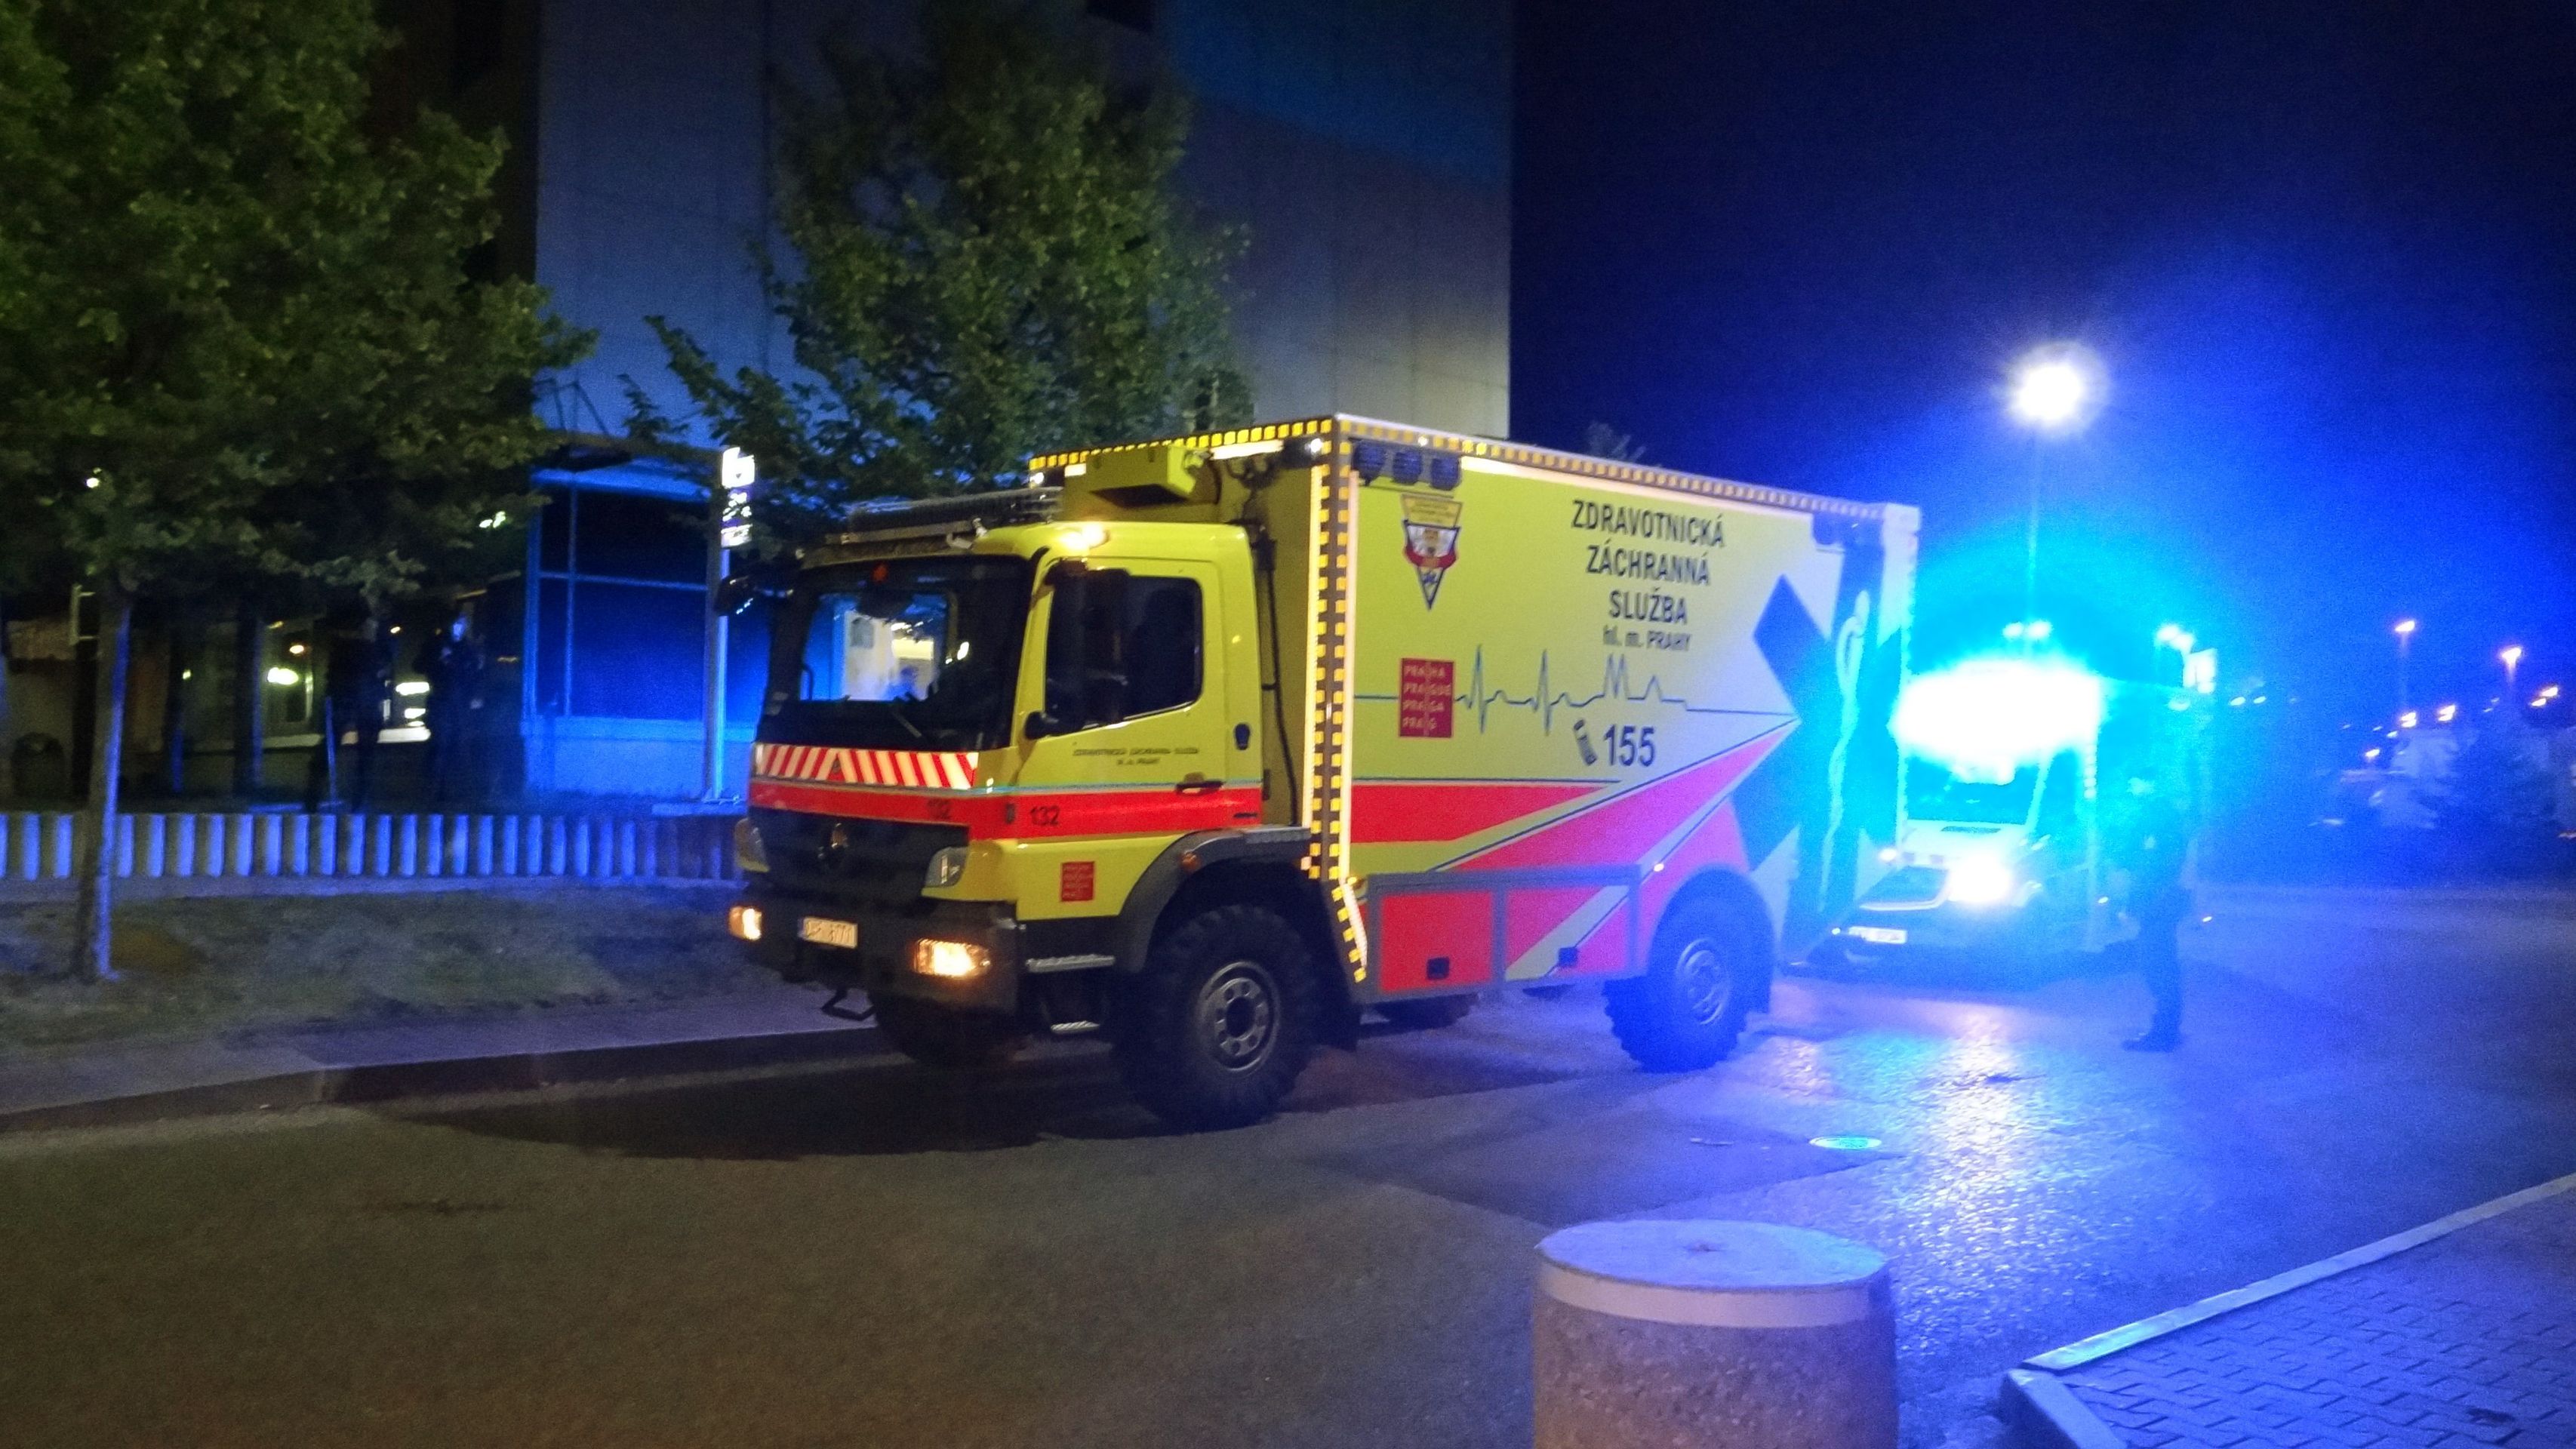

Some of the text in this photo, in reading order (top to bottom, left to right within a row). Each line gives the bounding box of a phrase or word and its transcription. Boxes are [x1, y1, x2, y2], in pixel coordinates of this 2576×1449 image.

[1571, 500, 1725, 547] ZDRAVOTNICKÁ
[1587, 537, 1710, 585] ZÁCHRANNÁ
[1608, 586, 1688, 624] SLUŽBA
[1603, 724, 1656, 767] 155
[1029, 804, 1061, 826] 132
